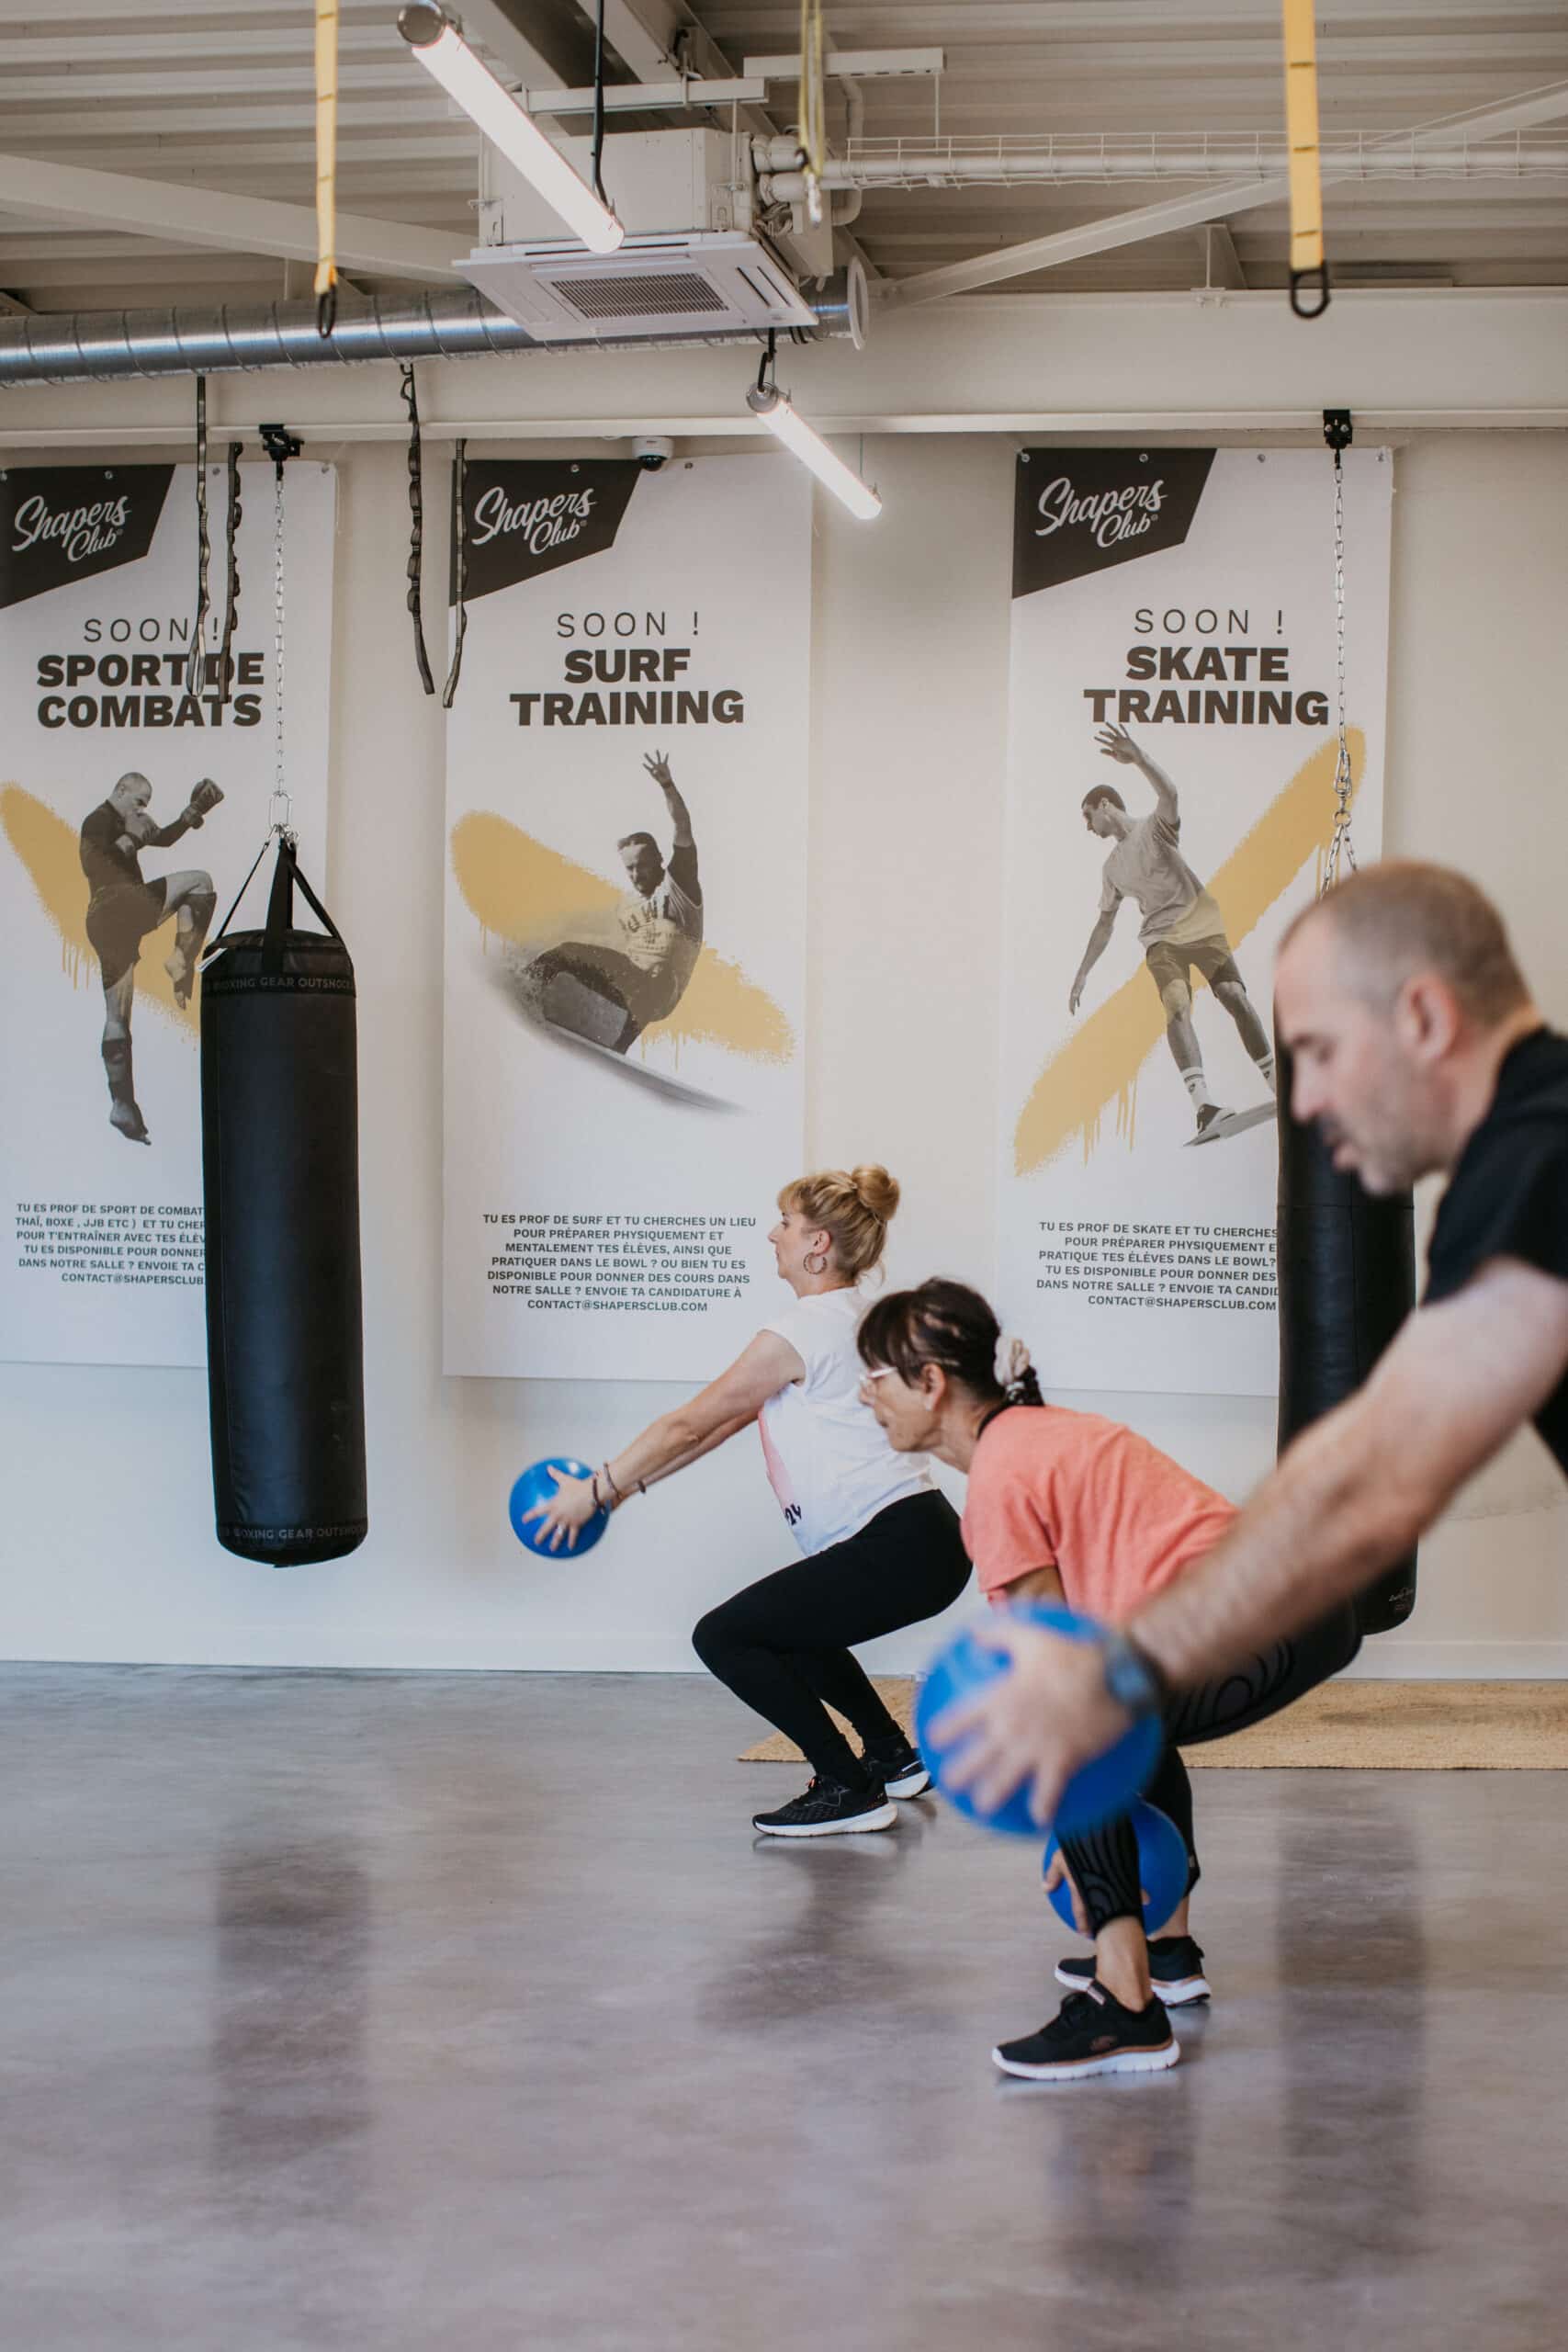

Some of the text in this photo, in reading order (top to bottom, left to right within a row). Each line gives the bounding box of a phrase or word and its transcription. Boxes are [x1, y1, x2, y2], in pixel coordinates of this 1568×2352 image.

[1035, 477, 1168, 537] Shapers
[12, 495, 132, 551] Shapers
[471, 486, 596, 545] Shapers
[84, 616, 188, 642] SOON
[557, 610, 666, 638] SOON
[1134, 609, 1249, 634] SOON
[37, 652, 265, 687] SPORT DE
[564, 648, 691, 684] SURF
[1126, 646, 1289, 682] SKATE
[38, 694, 263, 728] COMBATS
[510, 690, 744, 726] TRAINING
[1083, 689, 1329, 726] TRAINING
[17, 1204, 30, 1213] TU
[33, 1204, 47, 1213] ES
[50, 1204, 79, 1213] PROF
[82, 1204, 96, 1214] DE
[99, 1204, 137, 1215] SPORT
[140, 1205, 154, 1215] DE
[46, 1217, 73, 1227] BOXE
[107, 1219, 129, 1228] ETC
[142, 1219, 157, 1228] ET
[160, 1220, 175, 1229] TU
[483, 1214, 756, 1227] TU ES PROF DE SURF ET TU CHERCHES UN LIEU
[17, 1230, 45, 1240] POUR
[123, 1232, 152, 1243] AVEC
[154, 1234, 176, 1243] TES
[513, 1227, 724, 1242] POUR PRÉPARER PHYSIQUEMENT ET
[1040, 1222, 1279, 1238] TU ES PROF DE SKATE ET TU CHERCHES
[25, 1244, 39, 1254] TU
[40, 1245, 54, 1254] ES
[57, 1245, 123, 1256] DISPONIBLE
[127, 1247, 158, 1256] POUR
[505, 1242, 594, 1253] MENTALEMENT
[596, 1244, 619, 1253] TES
[672, 1245, 704, 1254] AINSI
[707, 1245, 732, 1257] QUE
[1065, 1237, 1098, 1247] POUR
[1101, 1236, 1165, 1250] PRÉPARER
[1168, 1240, 1265, 1253] PHYSIQUEMENT
[18, 1258, 47, 1268] DANS
[50, 1259, 86, 1269] NOTRE
[90, 1260, 125, 1270] SALLE
[138, 1261, 178, 1272] ENVOIE
[181, 1261, 195, 1272] TA
[491, 1257, 557, 1269] PRATIQUER
[560, 1258, 592, 1267] DANS
[595, 1258, 610, 1268] LE
[613, 1259, 648, 1268] BOWL
[660, 1259, 678, 1269] OU
[681, 1260, 708, 1269] BIEN
[712, 1260, 728, 1269] TU
[731, 1260, 746, 1270] ES
[1039, 1250, 1099, 1263] PRATIQUE
[1101, 1252, 1124, 1262] TES
[1178, 1254, 1211, 1265] DANS
[1214, 1256, 1229, 1266] LE
[487, 1271, 750, 1283] DISPONIBLE POUR DONNER DES COURS DANS
[1045, 1265, 1277, 1282] TU ES DISPONIBLE POUR DONNER DES
[492, 1284, 532, 1295] NOTRE
[535, 1285, 571, 1295] SALLE
[585, 1286, 628, 1296] ENVOIE
[631, 1287, 646, 1296] TA
[649, 1287, 731, 1297] CANDIDATURE
[1036, 1279, 1068, 1289] DANS
[1072, 1281, 1113, 1291] NOTRE
[1117, 1282, 1155, 1292] SALLE
[1168, 1283, 1214, 1295] ENVOIE
[1217, 1285, 1233, 1295] TA
[527, 1299, 707, 1312] CONTACT@SHAPERSCLUB.COM
[1088, 1295, 1276, 1311] CONTACT@SHAPERSCLUB.COM
[278, 1528, 314, 1539] GEAR
